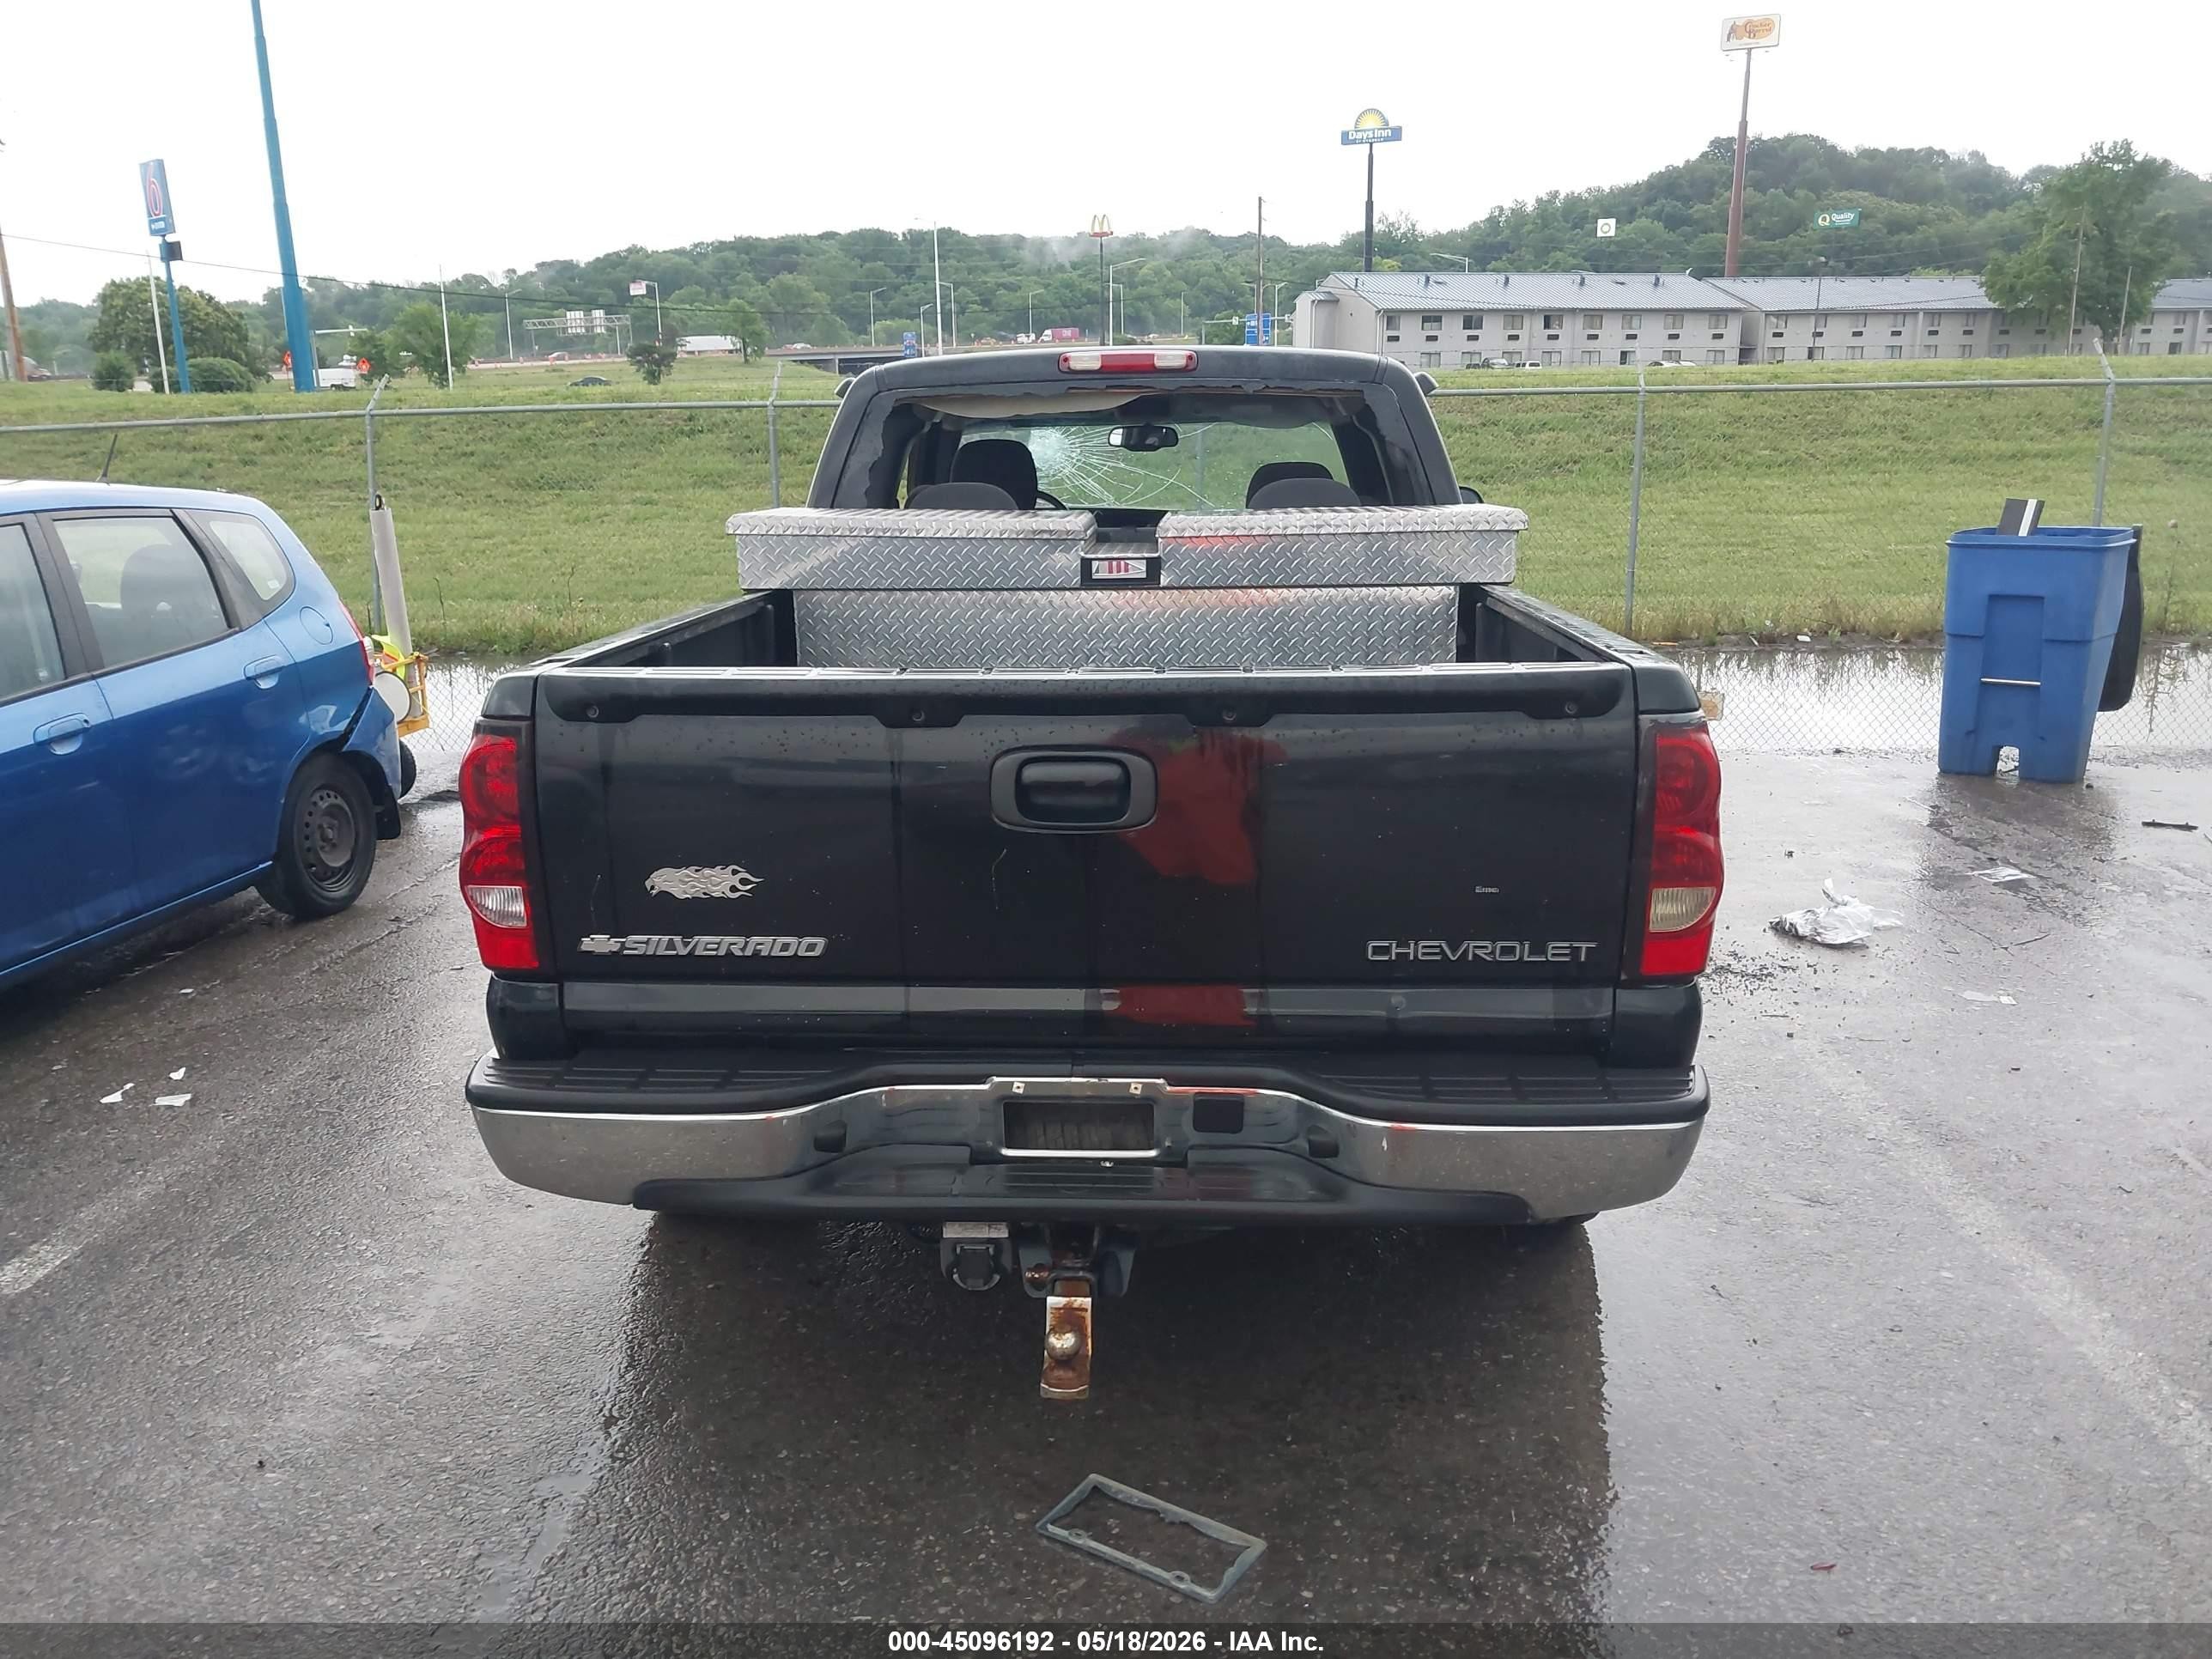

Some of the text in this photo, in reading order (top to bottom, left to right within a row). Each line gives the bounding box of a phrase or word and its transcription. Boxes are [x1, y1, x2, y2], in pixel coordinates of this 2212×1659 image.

[1348, 129, 1392, 140] Days Inn
[147, 165, 163, 217] 6
[1832, 212, 1855, 222] Quality
[623, 935, 829, 957] SILVERADO
[1366, 940, 1599, 962] CHEVROLET
